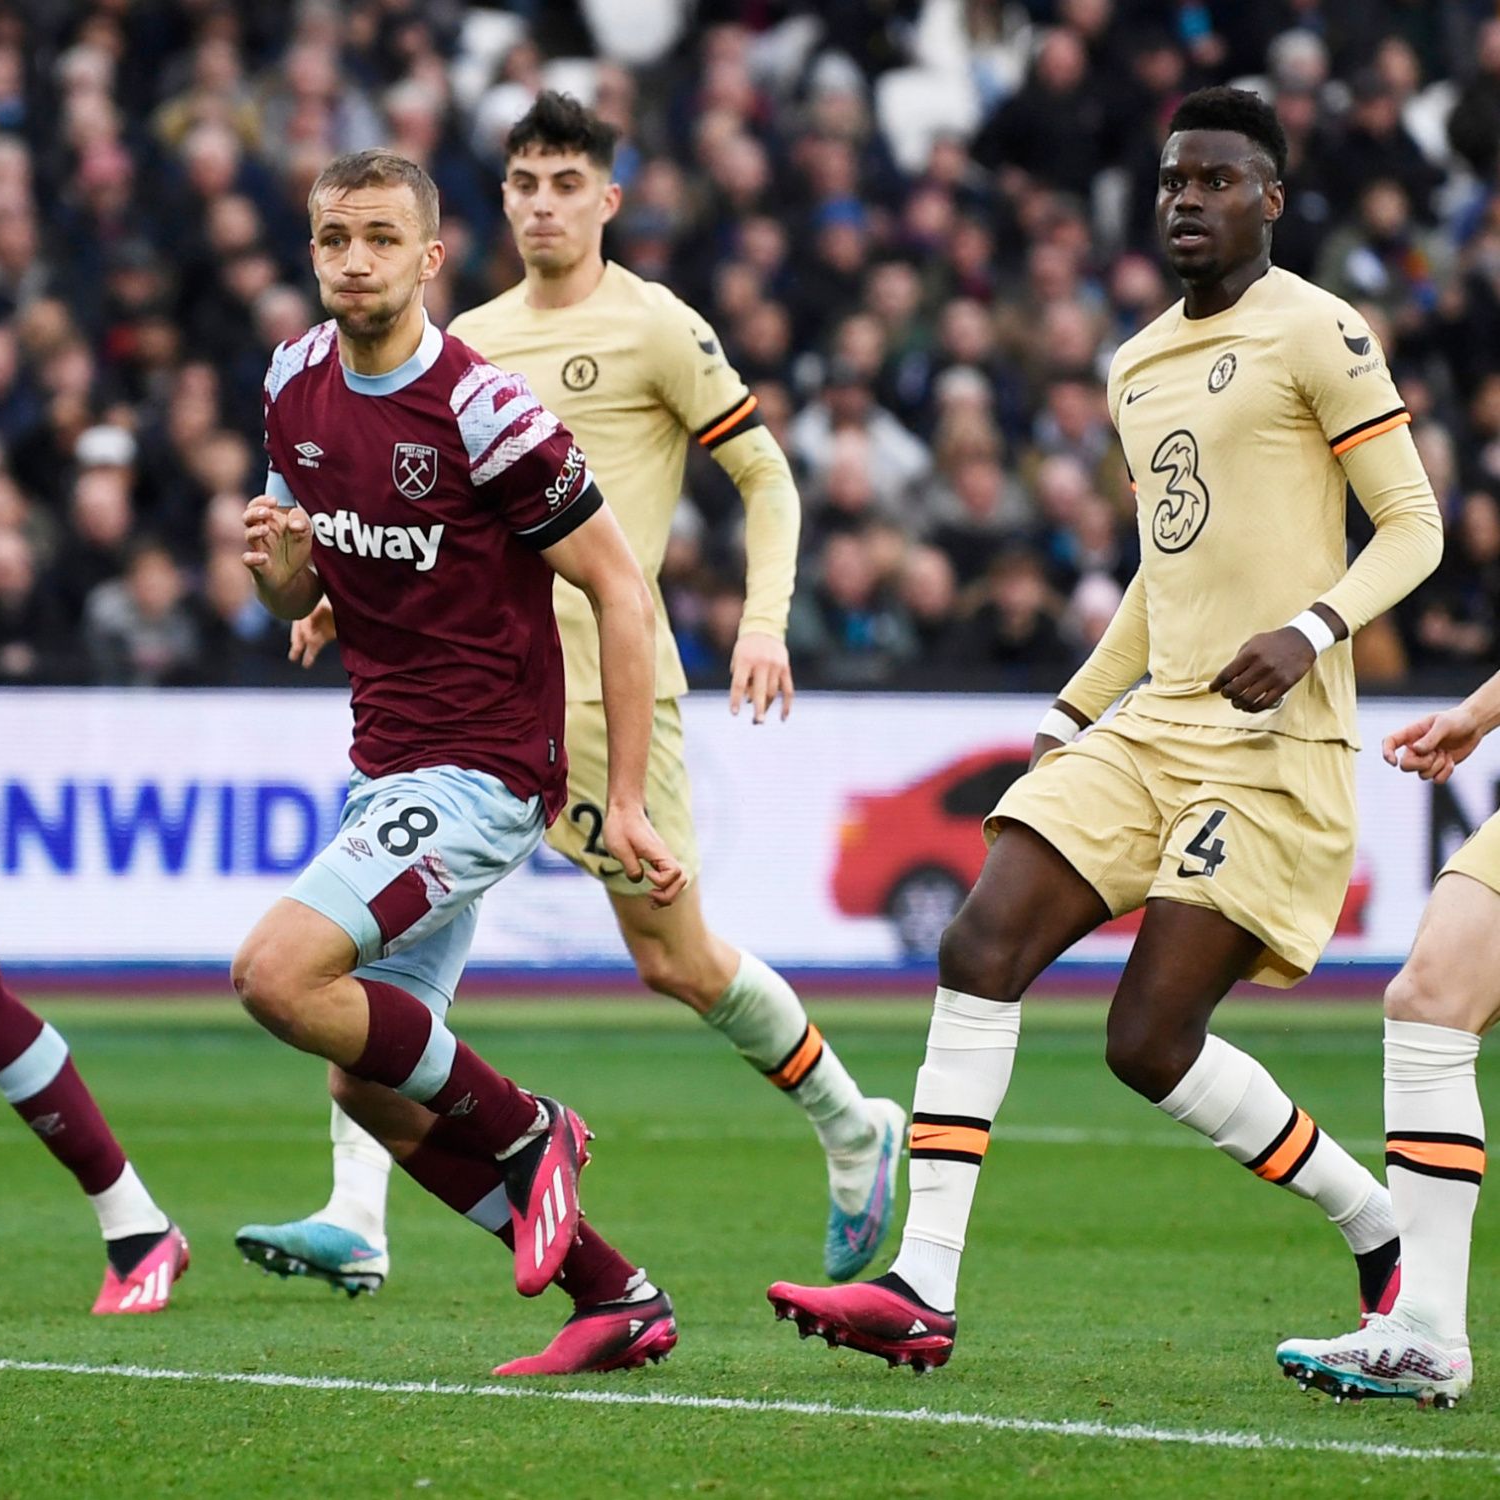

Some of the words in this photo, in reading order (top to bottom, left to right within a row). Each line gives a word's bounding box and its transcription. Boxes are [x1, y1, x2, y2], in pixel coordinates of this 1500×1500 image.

[1151, 429, 1210, 554] 3
[311, 509, 445, 572] etway
[355, 797, 439, 857] 8
[1183, 809, 1227, 878] 4
